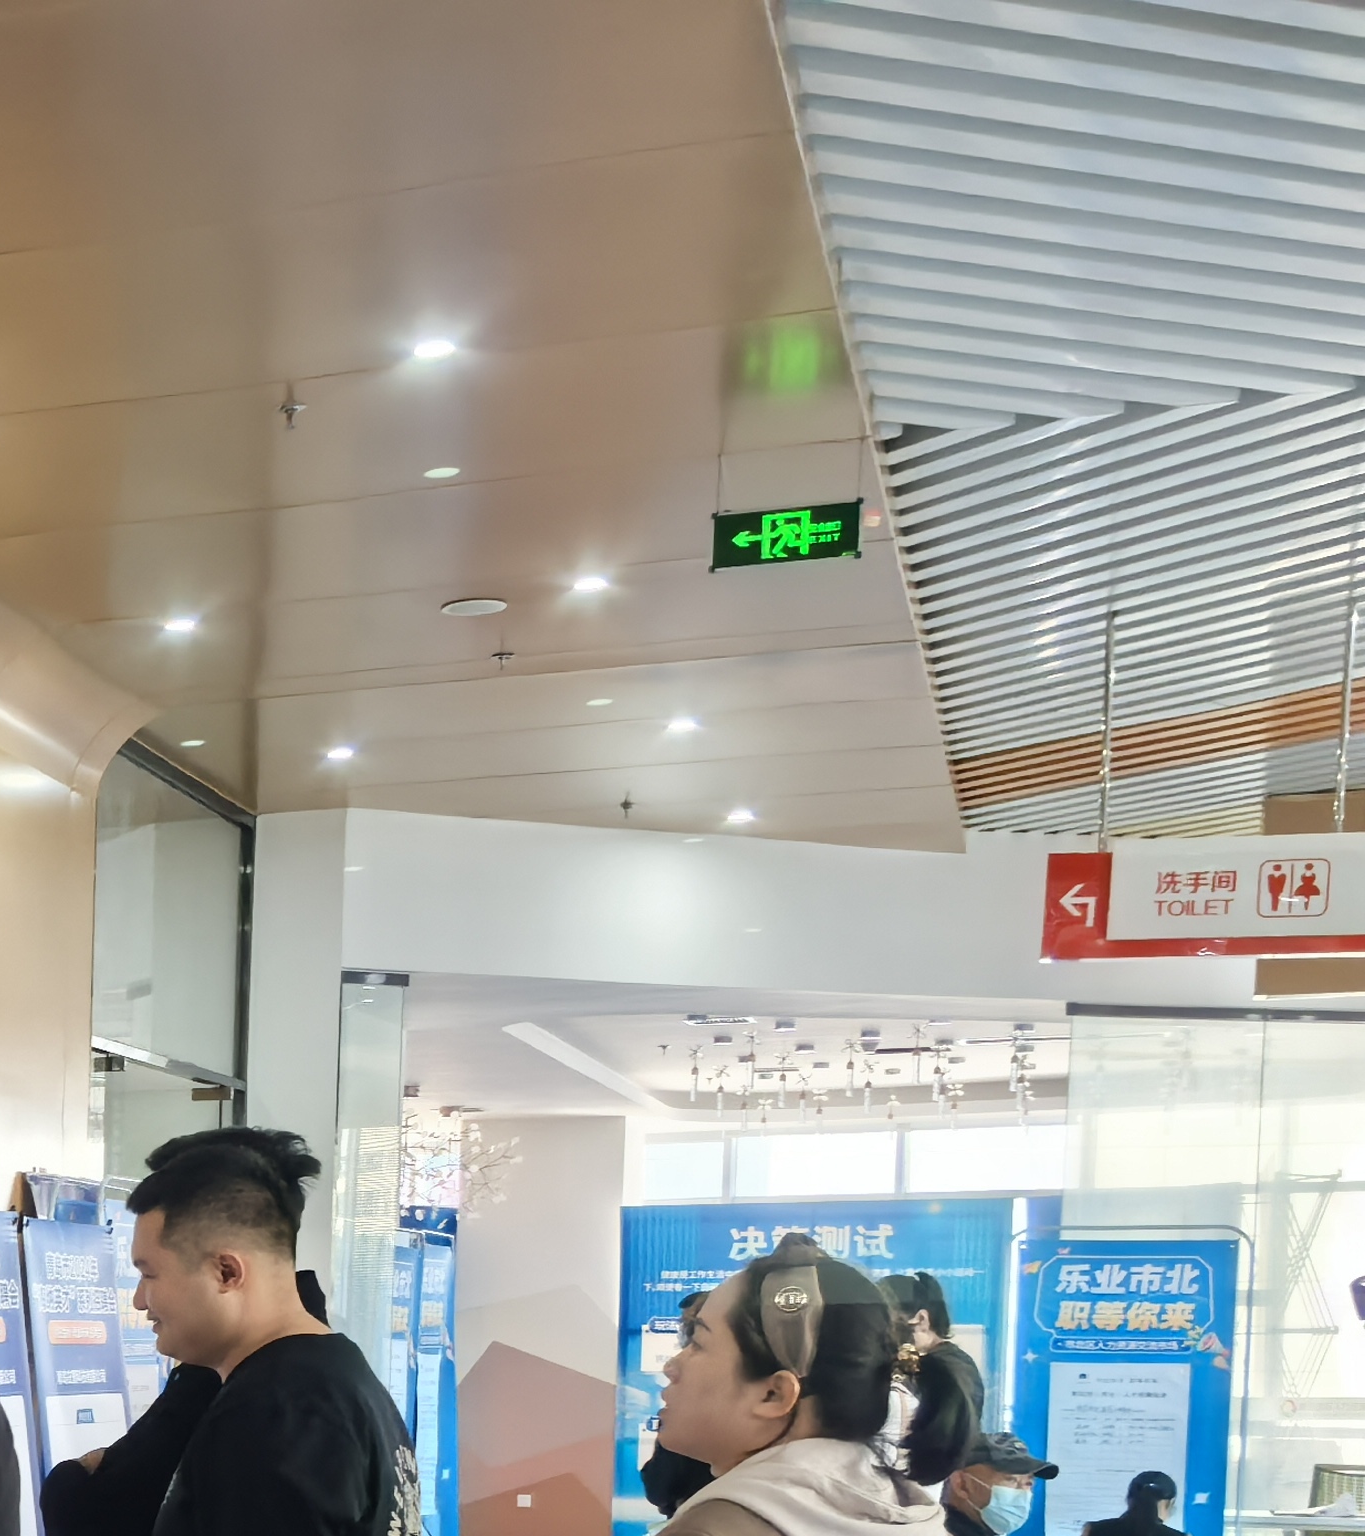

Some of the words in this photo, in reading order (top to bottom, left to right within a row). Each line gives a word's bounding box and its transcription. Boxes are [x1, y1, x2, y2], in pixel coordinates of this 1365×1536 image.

[1155, 870, 1237, 895] 洗手间
[1154, 898, 1234, 916] TOILET
[1055, 1263, 1201, 1295] 乐业市北
[1054, 1300, 1196, 1331] 职等你来
